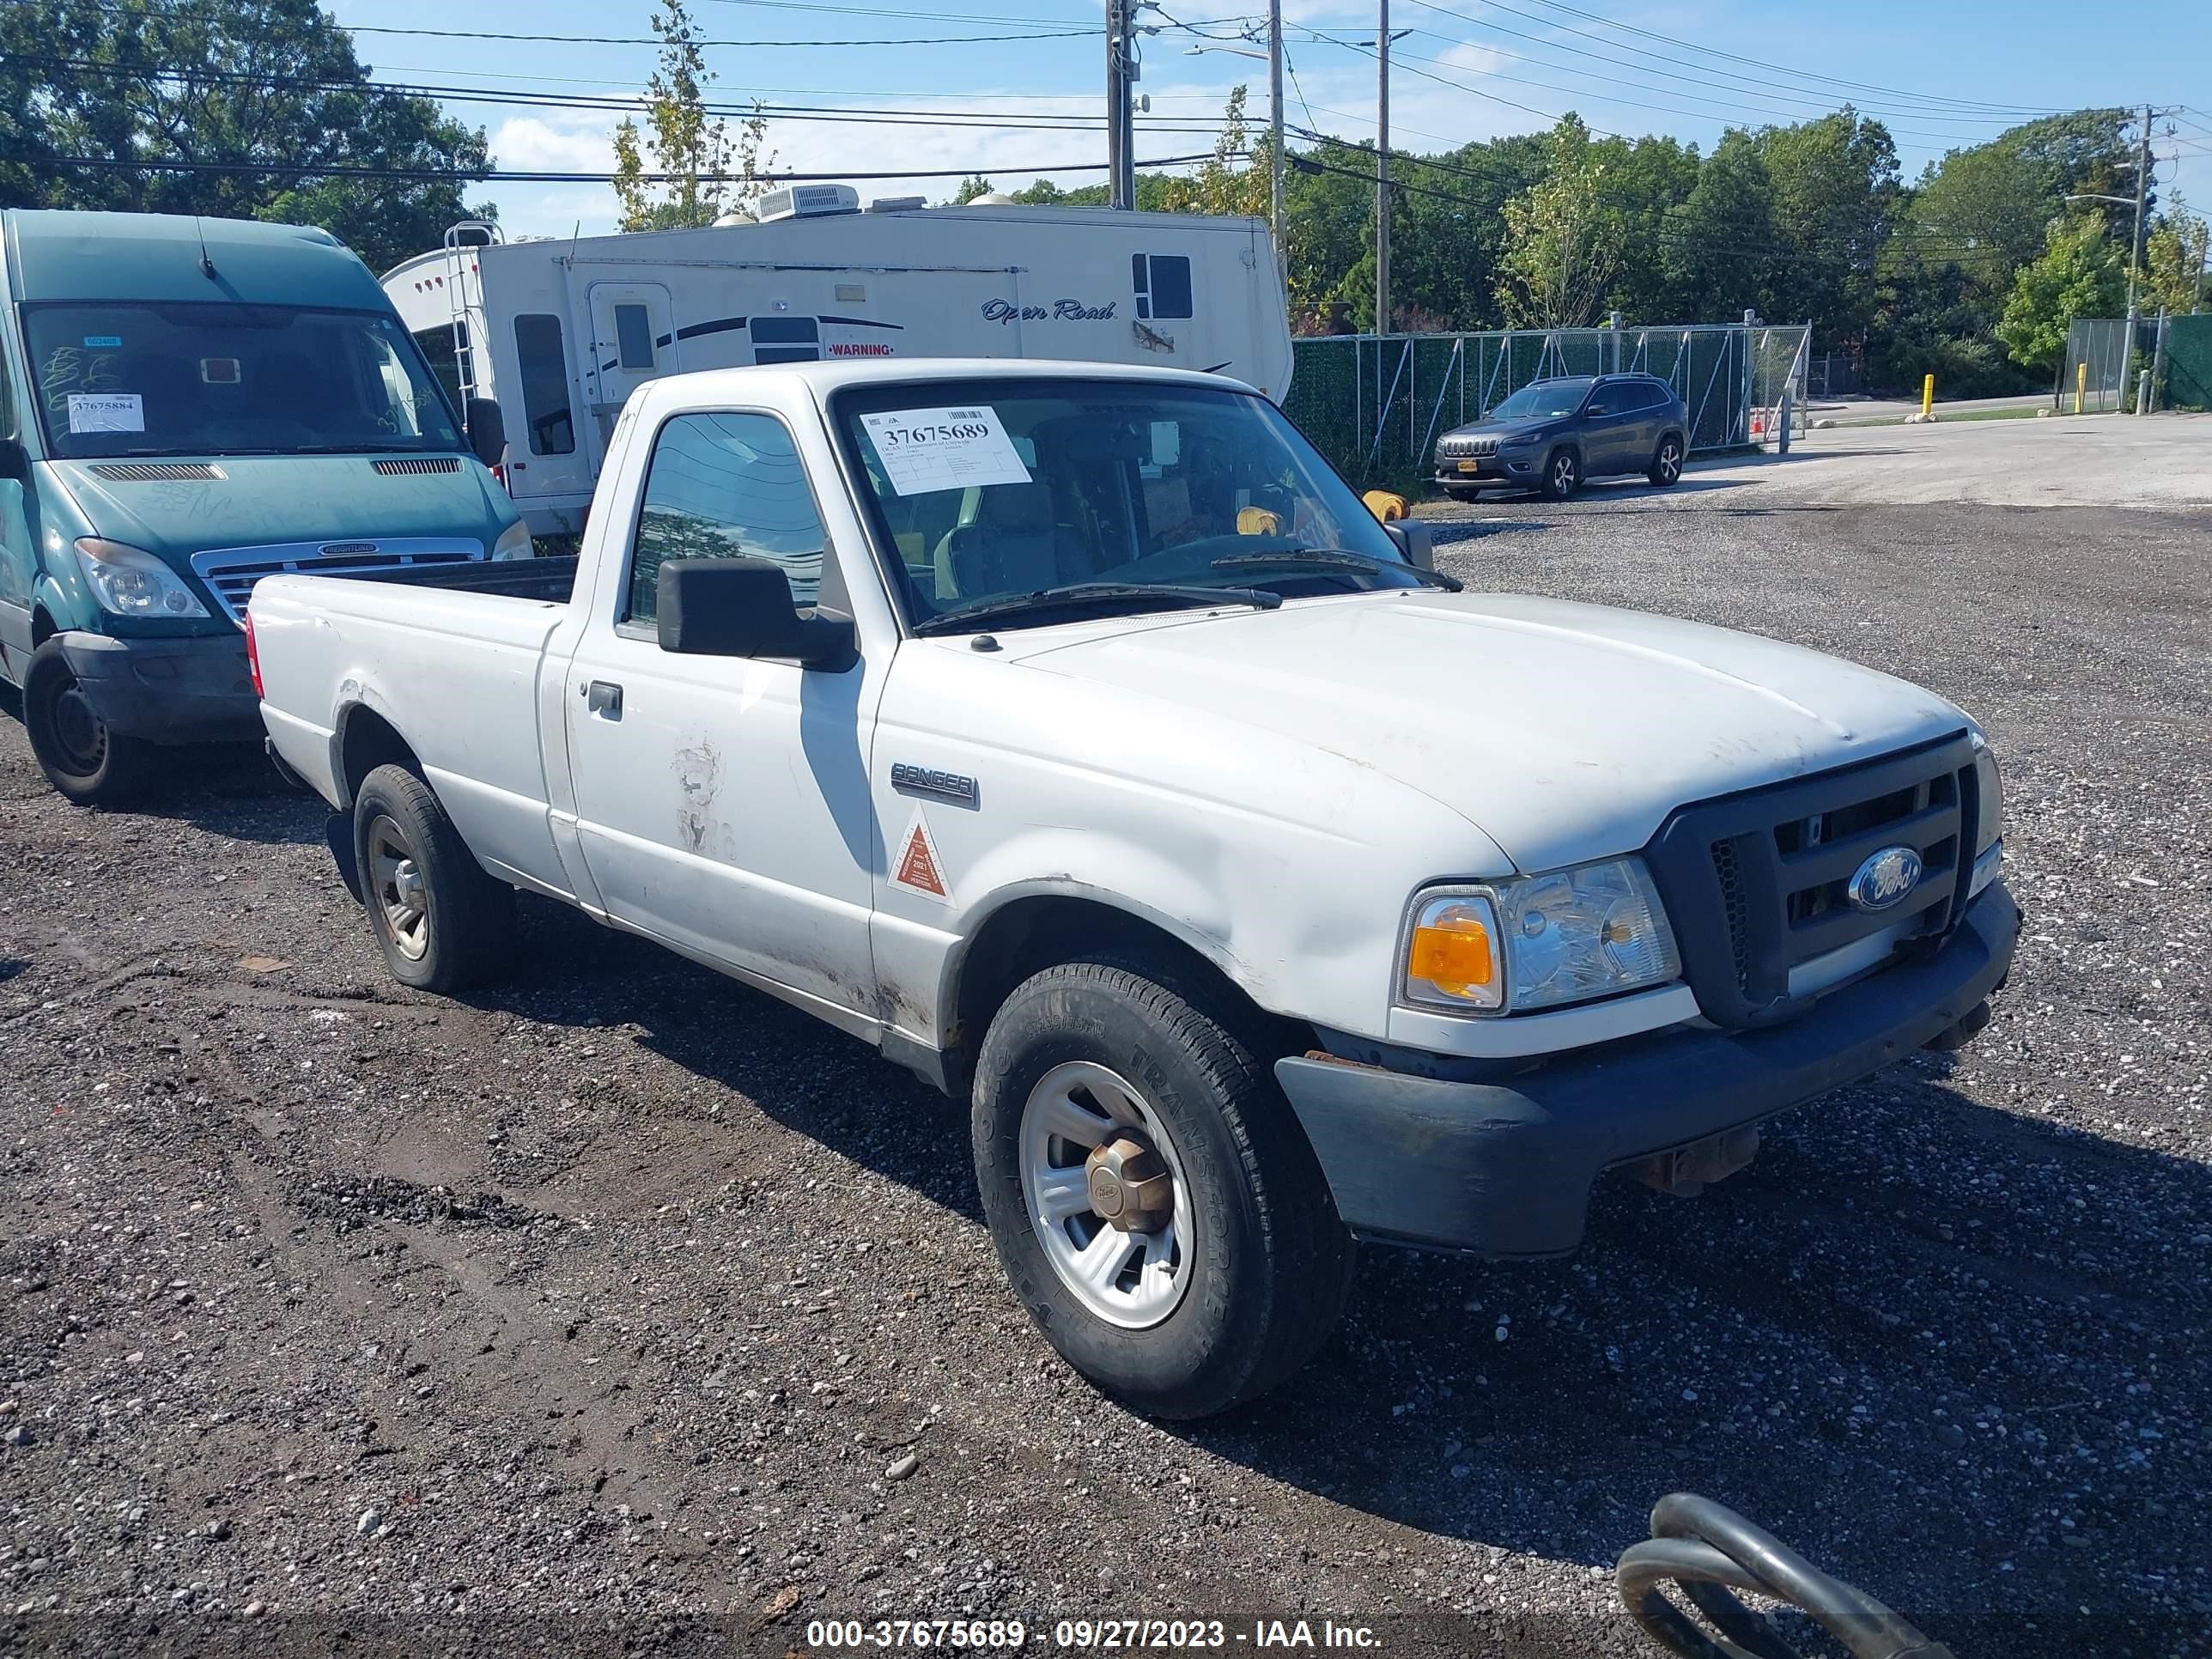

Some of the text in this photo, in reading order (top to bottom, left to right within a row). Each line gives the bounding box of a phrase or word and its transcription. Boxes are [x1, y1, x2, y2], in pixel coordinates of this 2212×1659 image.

[981, 298, 1116, 325] Open Road
[832, 344, 890, 356] WARNING
[74, 401, 133, 410] 37675884
[884, 423, 988, 446] 37675689
[892, 763, 973, 795] RANGER
[913, 860, 927, 871] 2021
[1129, 1042, 1231, 1322] TRANSFORCE
